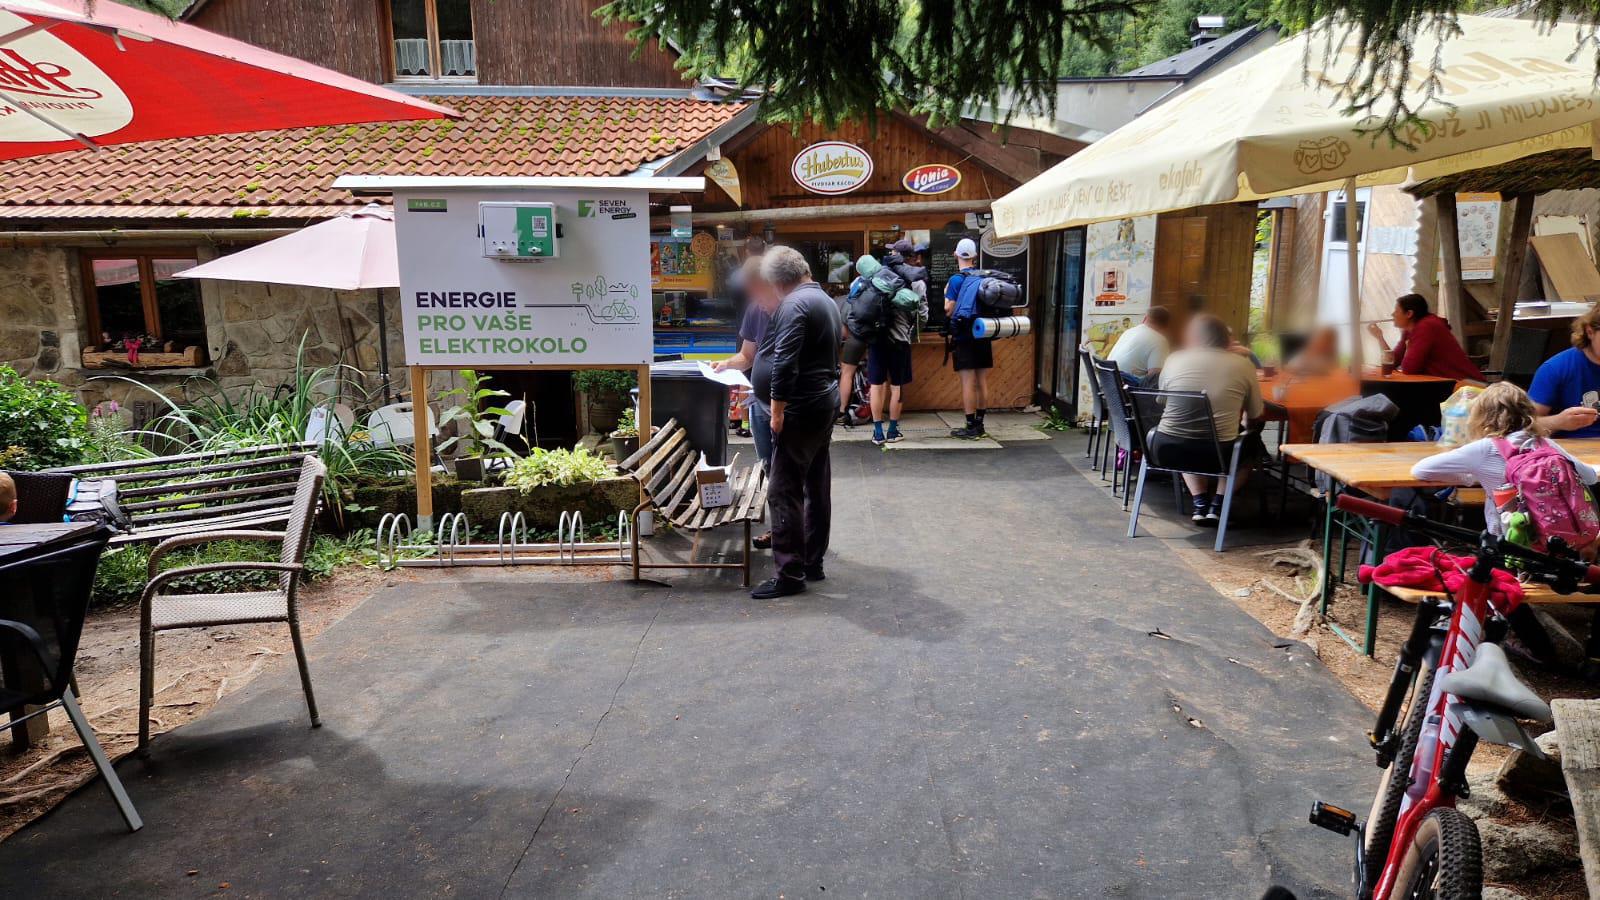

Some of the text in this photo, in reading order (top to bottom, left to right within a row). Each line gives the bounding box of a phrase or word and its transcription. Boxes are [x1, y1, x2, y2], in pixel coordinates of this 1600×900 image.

[1474, 110, 1491, 131] JI
[800, 150, 865, 177] Hubertus
[599, 199, 626, 207] SEVEN
[415, 291, 517, 308] ENERGIE
[417, 310, 532, 332] PRO VAŠE
[419, 336, 588, 354] ELEKTROKOLO
